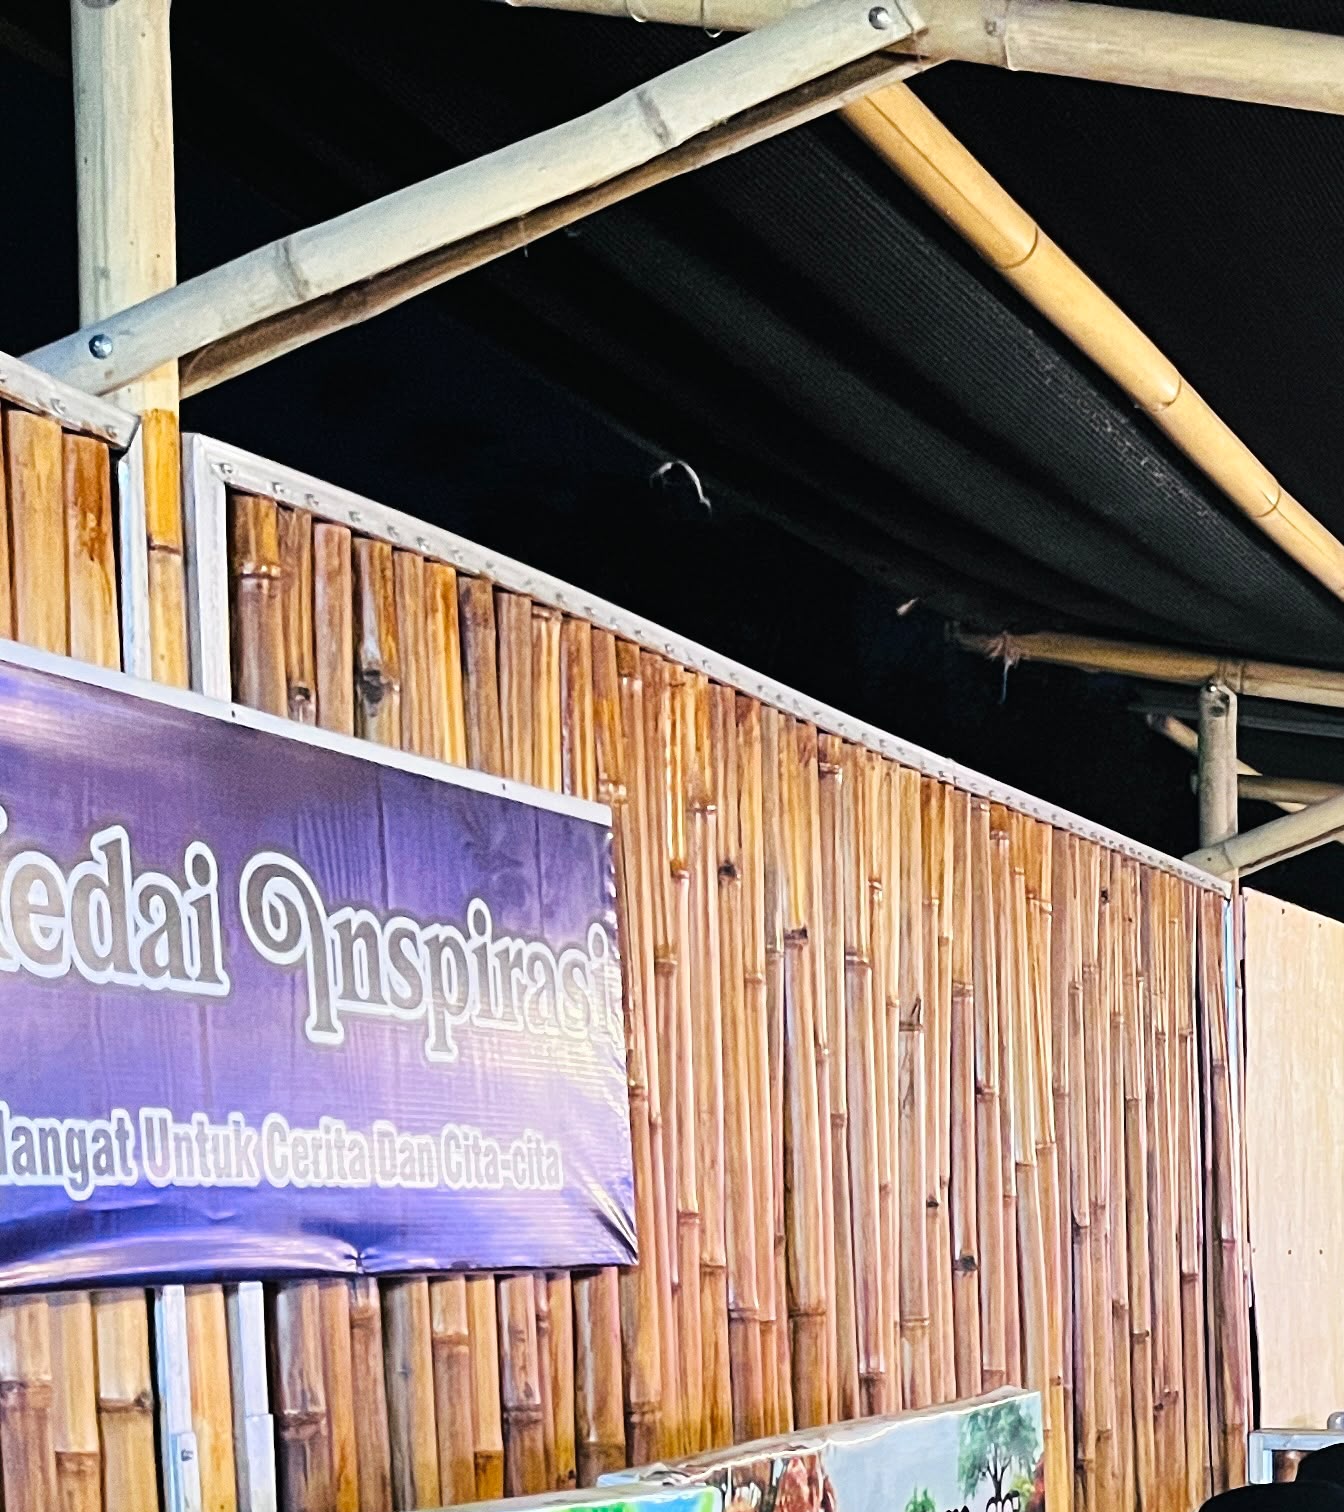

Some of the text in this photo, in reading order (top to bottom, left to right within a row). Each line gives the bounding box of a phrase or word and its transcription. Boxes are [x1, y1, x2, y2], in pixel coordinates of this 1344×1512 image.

[239, 851, 619, 1063] Inspirasi
[0, 1084, 137, 1201] angat
[139, 1107, 260, 1188] Untuk
[262, 1112, 373, 1189] Cerita
[440, 1125, 563, 1191] Cita-cita
